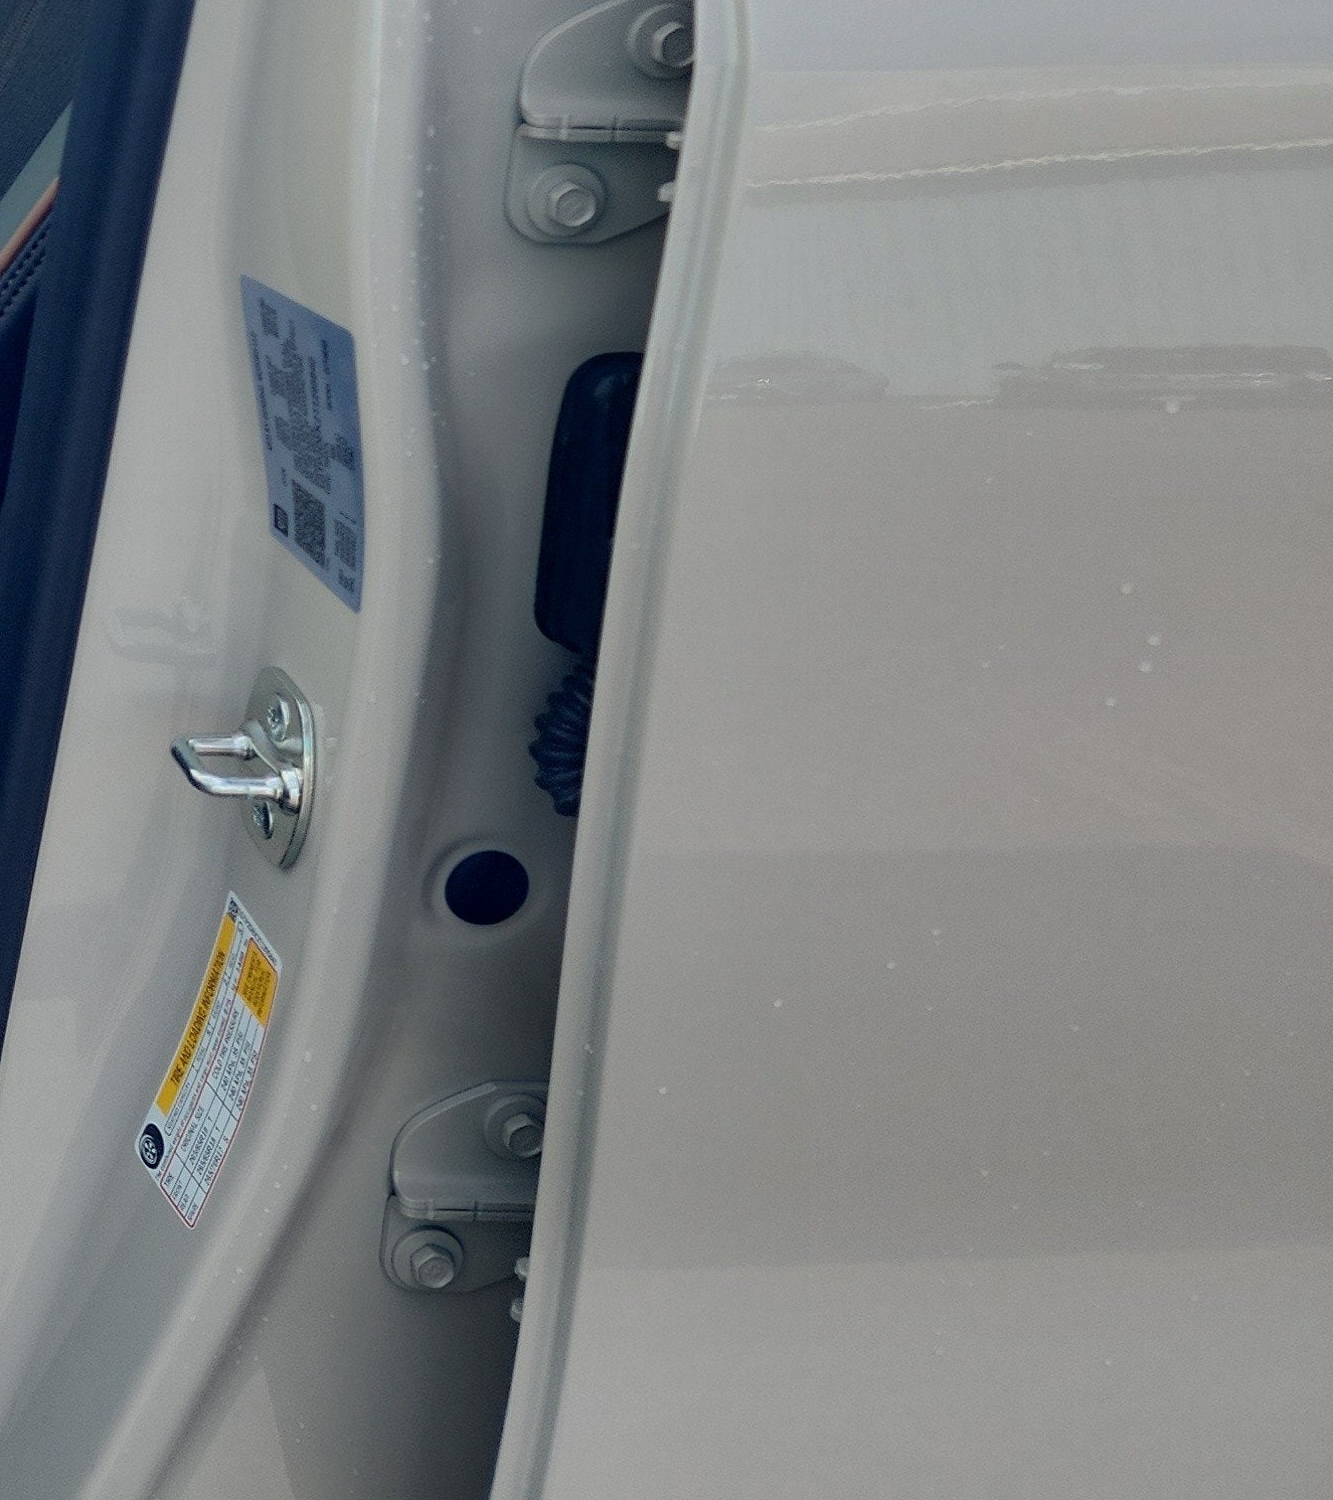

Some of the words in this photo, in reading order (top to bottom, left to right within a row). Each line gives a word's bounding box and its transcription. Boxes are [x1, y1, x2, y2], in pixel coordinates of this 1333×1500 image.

[170, 1065, 183, 1087] TIRE
[180, 1044, 191, 1066] AND
[189, 1007, 207, 1048] LOADING
[202, 951, 225, 1009] INFORMATION
